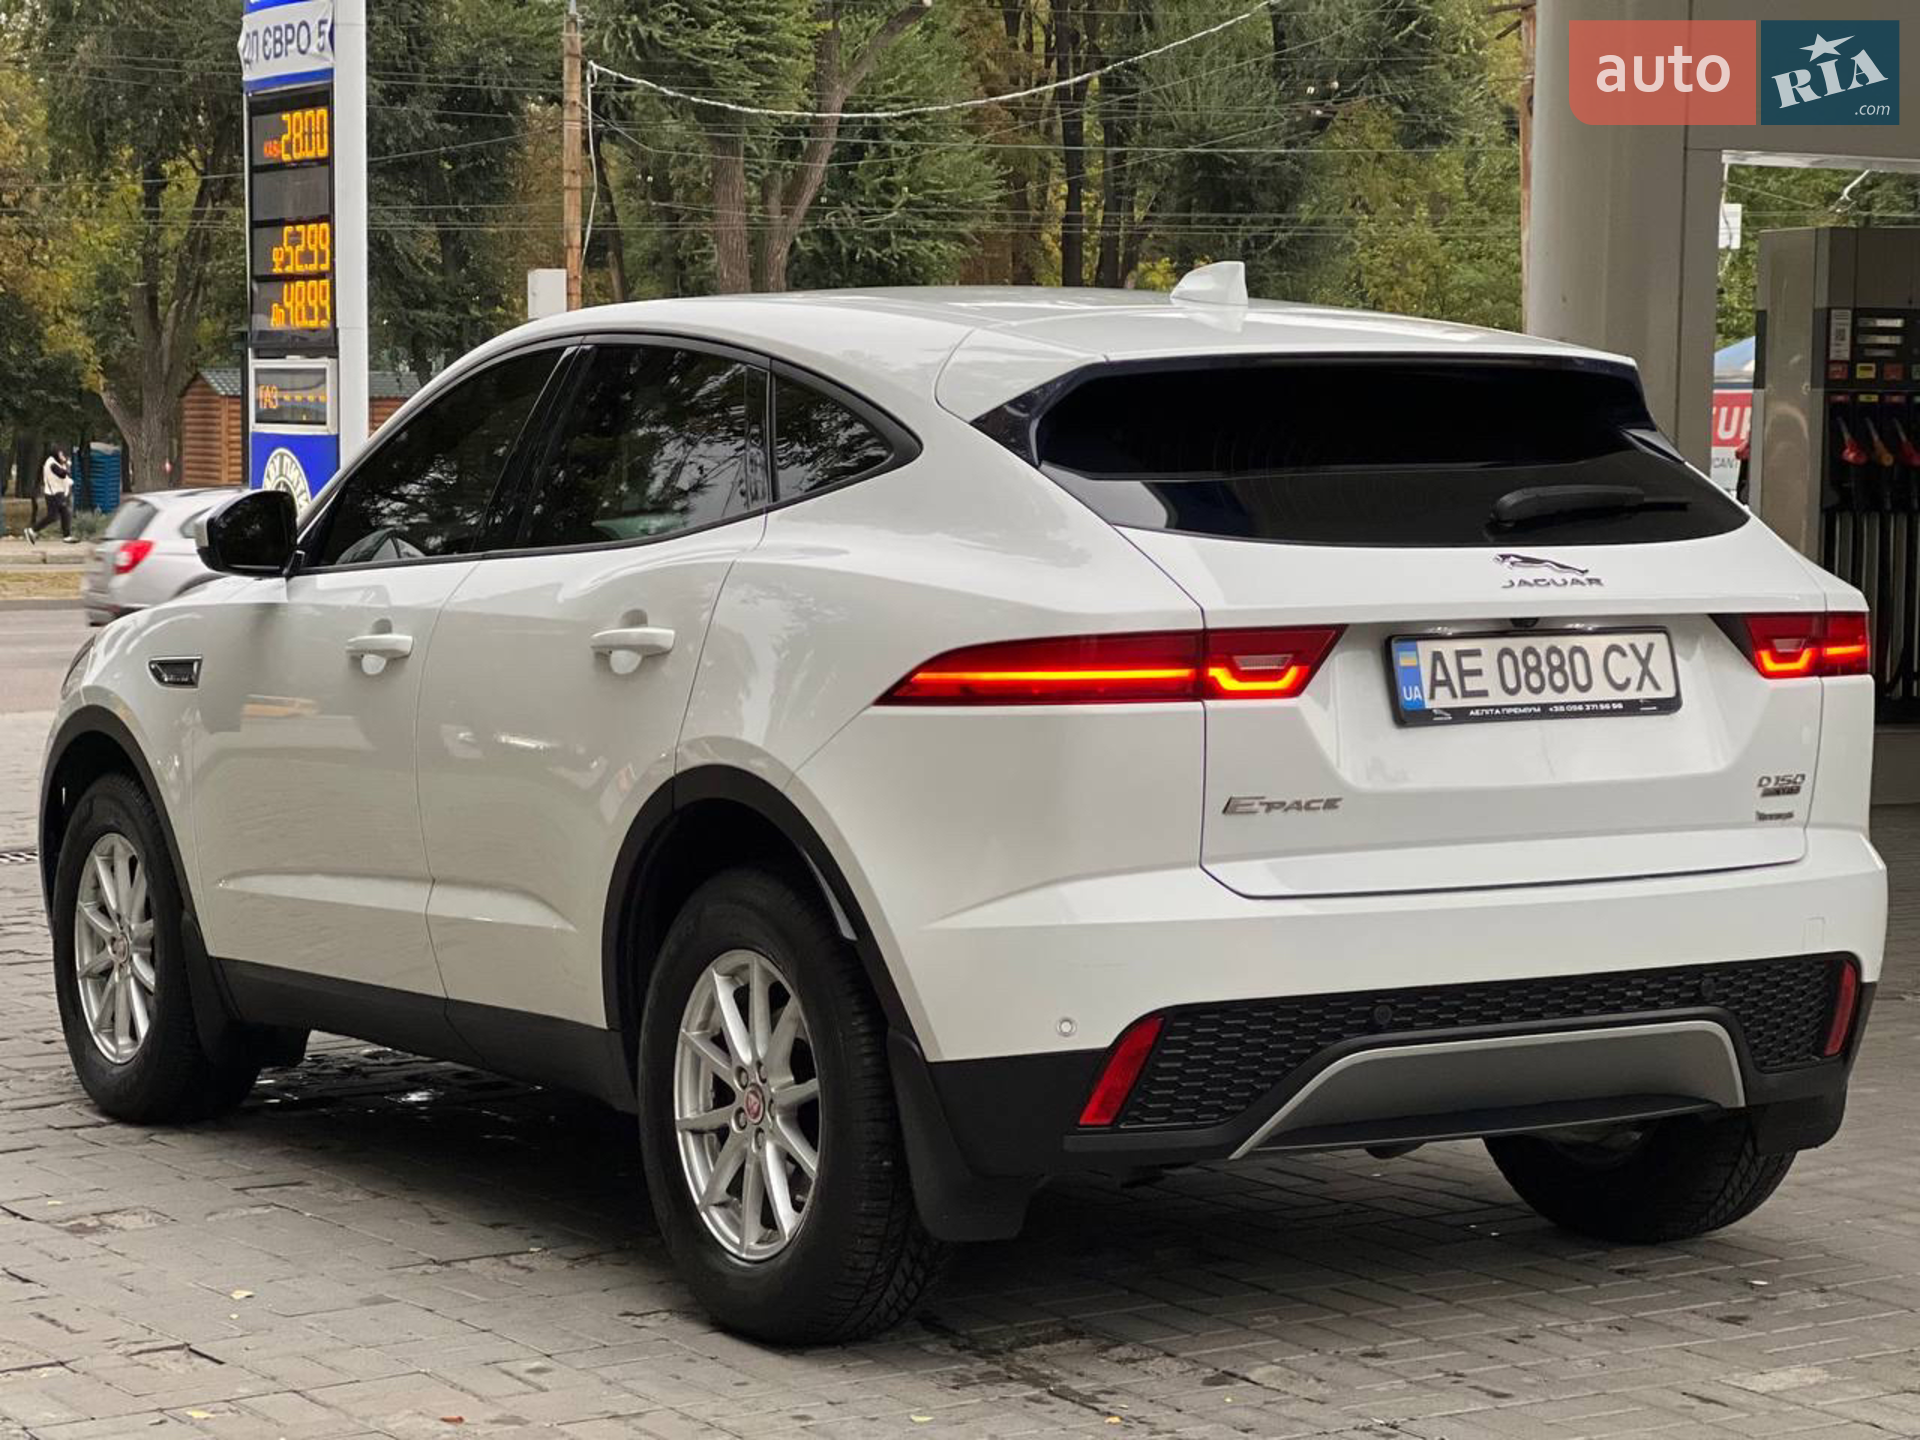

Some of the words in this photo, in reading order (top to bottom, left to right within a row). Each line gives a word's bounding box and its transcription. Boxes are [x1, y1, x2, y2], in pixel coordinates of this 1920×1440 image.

[262, 20, 312, 61] ЄВРО
[317, 18, 328, 52] 5
[1501, 578, 1605, 589] JAGUAR
[1428, 648, 1489, 700] AE
[1497, 645, 1593, 696] 0880
[1603, 642, 1662, 692] CX
[1402, 685, 1422, 701] UA
